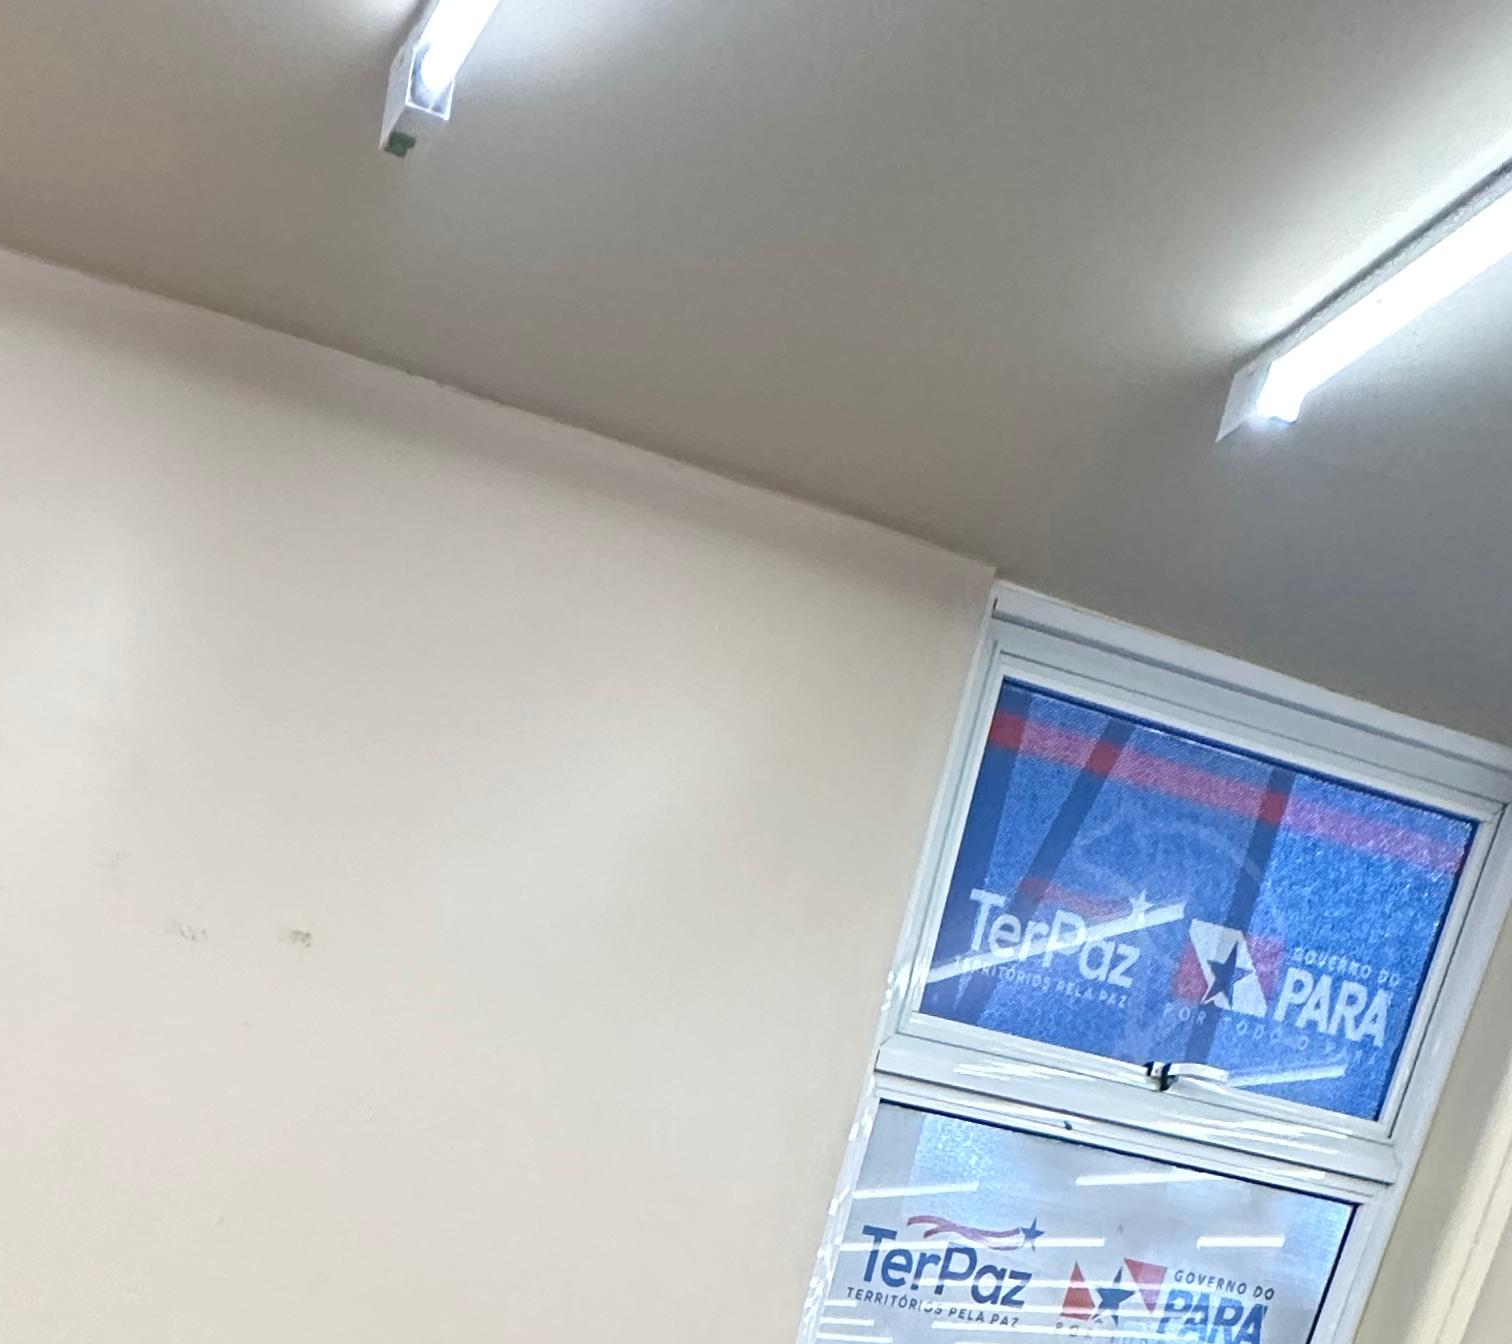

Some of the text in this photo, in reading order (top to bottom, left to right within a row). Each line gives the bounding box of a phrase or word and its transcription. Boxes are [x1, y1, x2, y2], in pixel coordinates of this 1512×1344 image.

[970, 888, 1141, 989] TerPaz
[1291, 948, 1401, 987] GOVERNO DO
[861, 1224, 1033, 1310] TerPaz
[1173, 1269, 1276, 1300] GOVERNO DO
[947, 1306, 986, 1323] PELA
